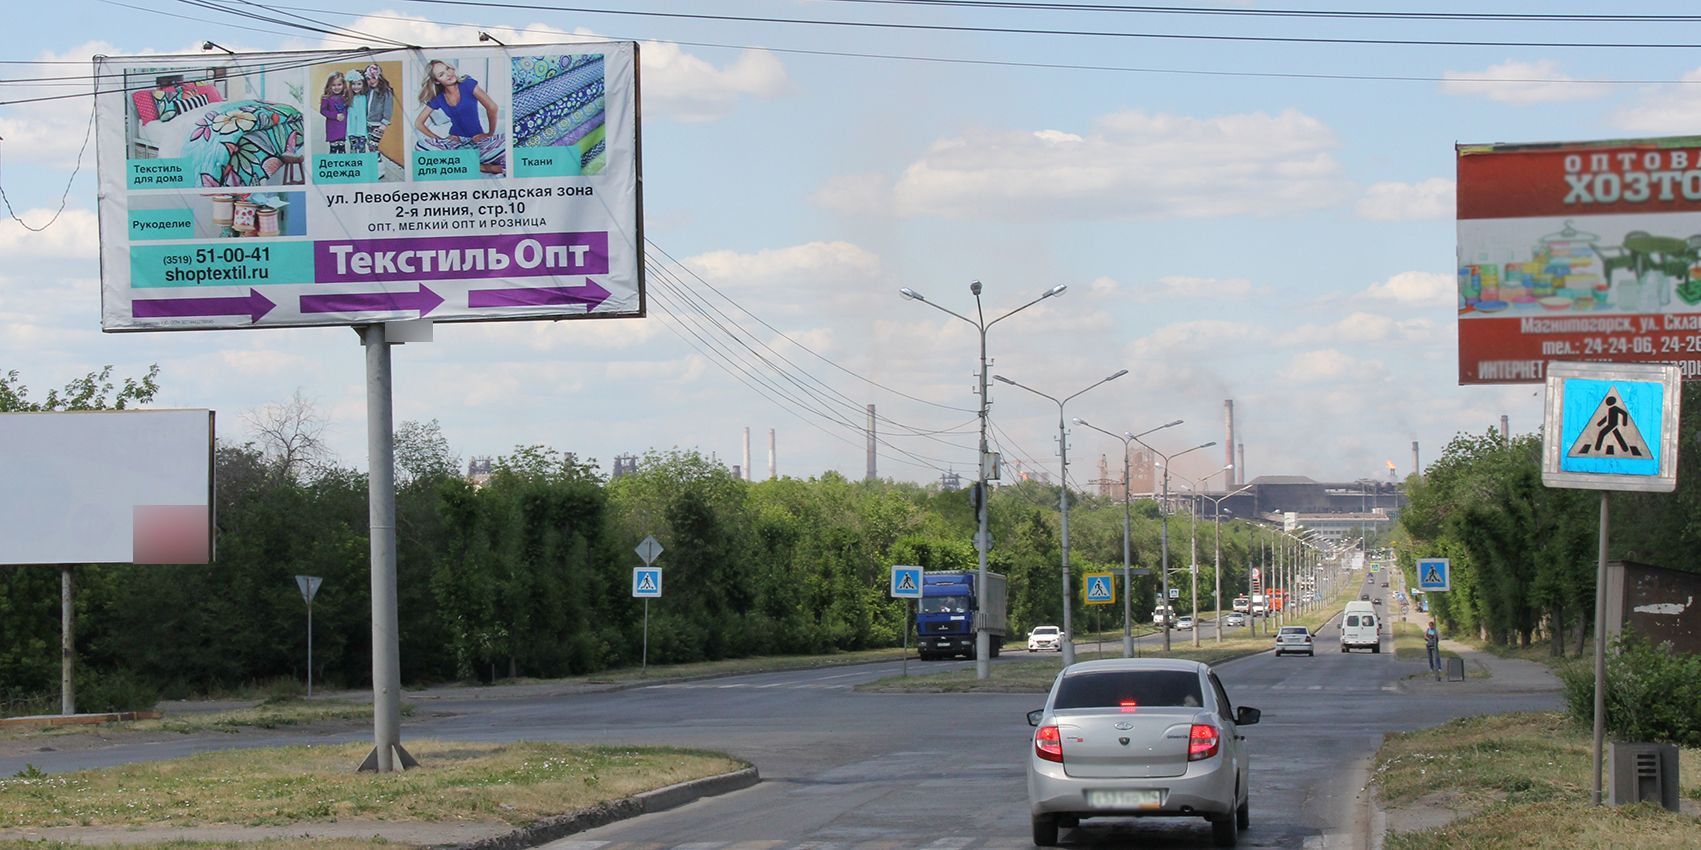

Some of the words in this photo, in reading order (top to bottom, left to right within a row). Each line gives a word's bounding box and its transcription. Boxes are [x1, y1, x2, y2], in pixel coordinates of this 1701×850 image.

[319, 160, 363, 169] Детская
[418, 156, 460, 166] Одежда
[522, 158, 553, 166] Ткани
[134, 165, 182, 174] Текстиль
[319, 169, 361, 178] одежда
[418, 166, 437, 175] для
[440, 165, 467, 174] дома
[134, 175, 153, 184] для
[156, 174, 183, 184] дома
[327, 194, 349, 207] ул.
[353, 189, 467, 205] Левобережная
[473, 187, 552, 200] складская
[557, 186, 593, 196] зона
[396, 206, 419, 218] 2-я
[424, 205, 474, 218] линия,
[479, 203, 525, 216] стр.10
[133, 220, 191, 230] Рукоделие
[368, 222, 395, 232] ОПТ,
[399, 220, 448, 231] МЕЛКИЙ
[452, 220, 475, 229] ОПТ
[479, 220, 487, 228] И
[491, 218, 547, 228] РОЗНИЦА
[163, 255, 192, 265] (3519)
[196, 247, 270, 262] 51-00-41
[165, 265, 268, 284] shoptextil.ru
[1520, 317, 1636, 334] Магнитогорск,
[1640, 316, 1660, 334] ул.
[1542, 340, 1580, 355] тел.:
[1584, 336, 1657, 356] 24-24-06,
[1478, 361, 1544, 380] ИНТЕРНЕТ
